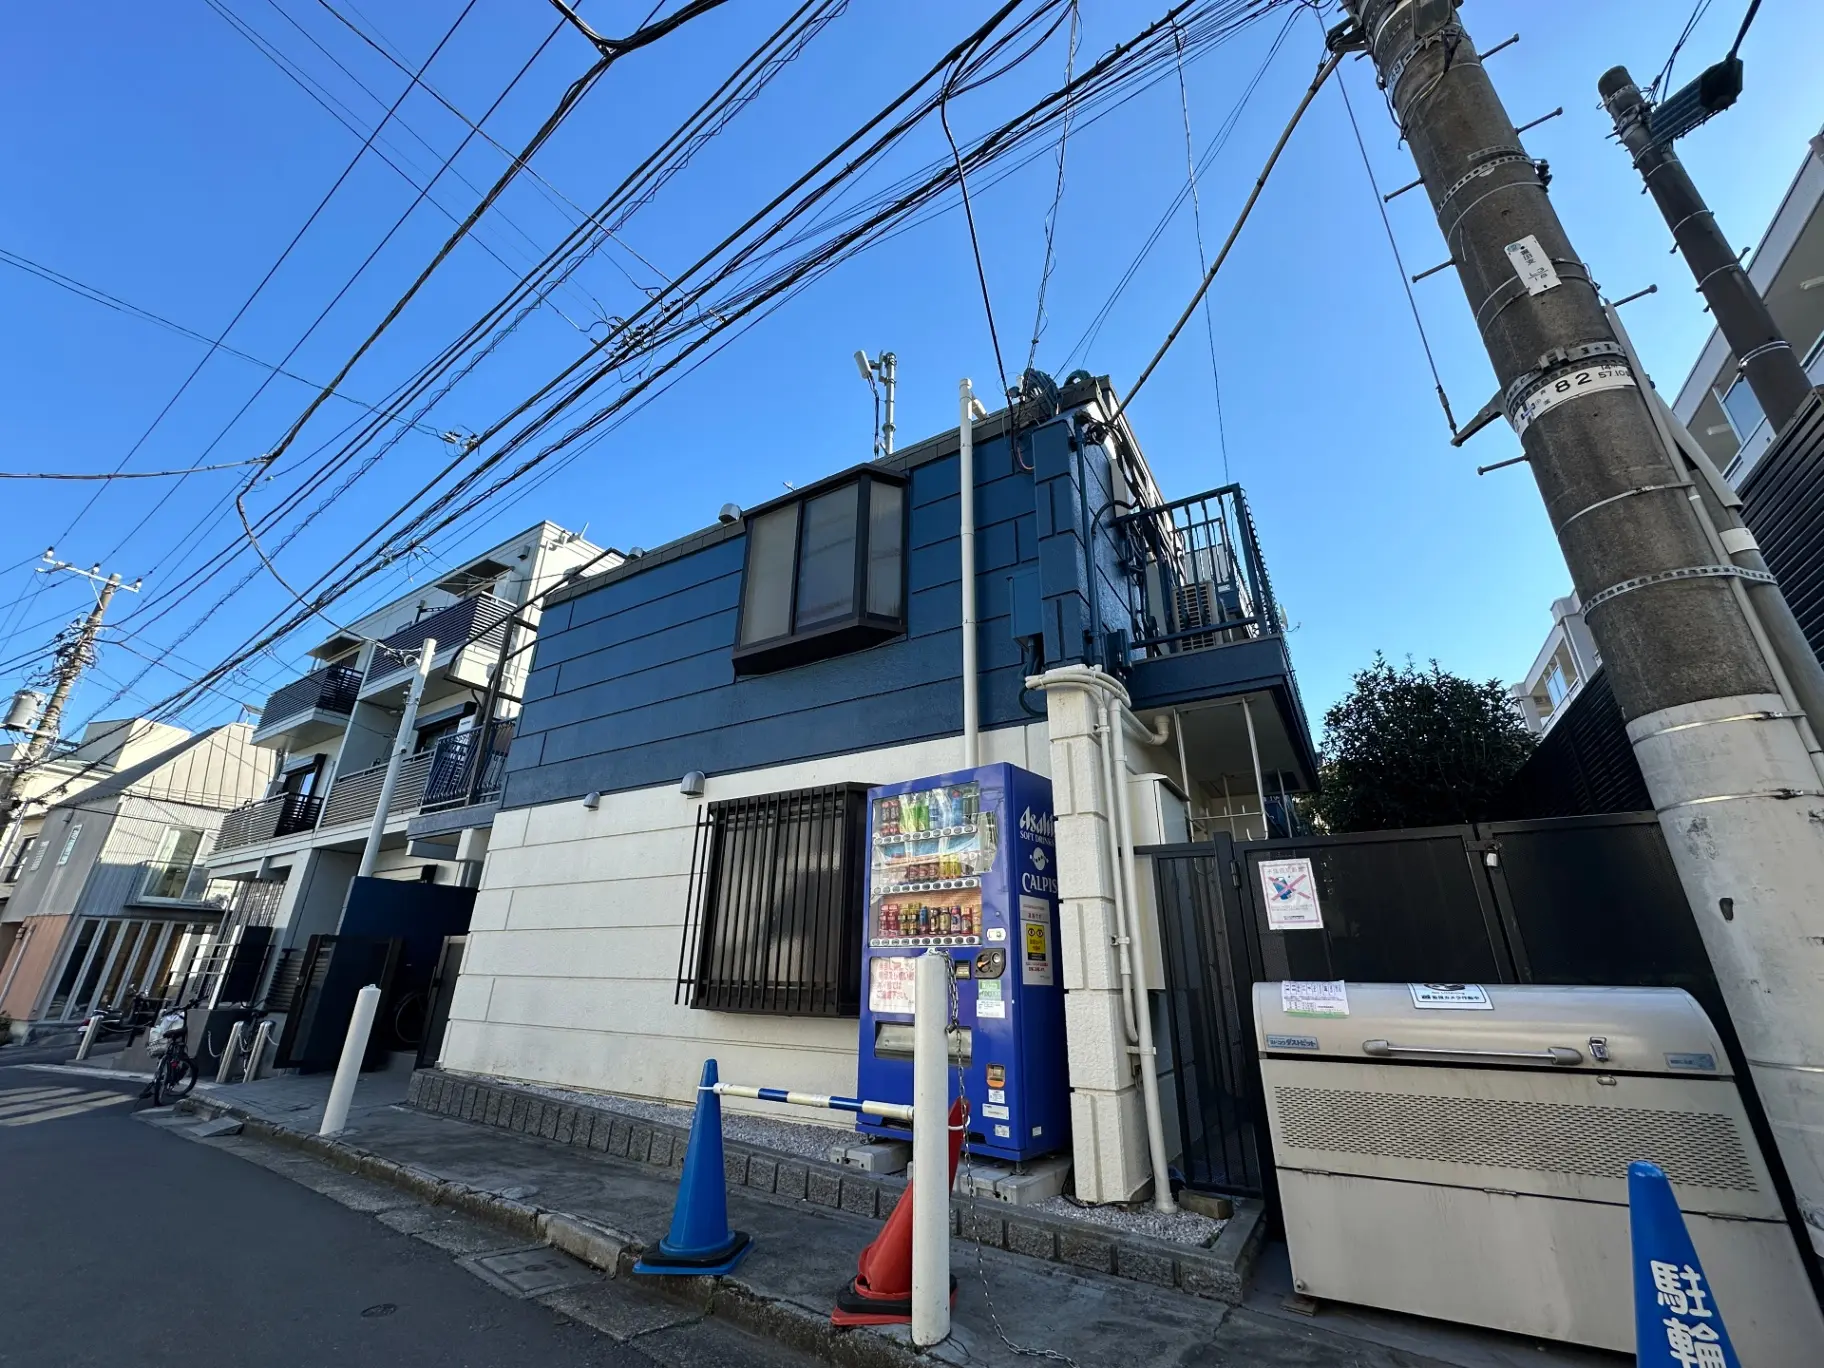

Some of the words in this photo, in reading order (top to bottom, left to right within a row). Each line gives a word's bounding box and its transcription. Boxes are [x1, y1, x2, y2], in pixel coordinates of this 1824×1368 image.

[1554, 371, 1592, 393] 82
[1019, 805, 1055, 838] Asahi
[1019, 830, 1035, 842] SOFT
[1021, 872, 1058, 894] CALPIS
